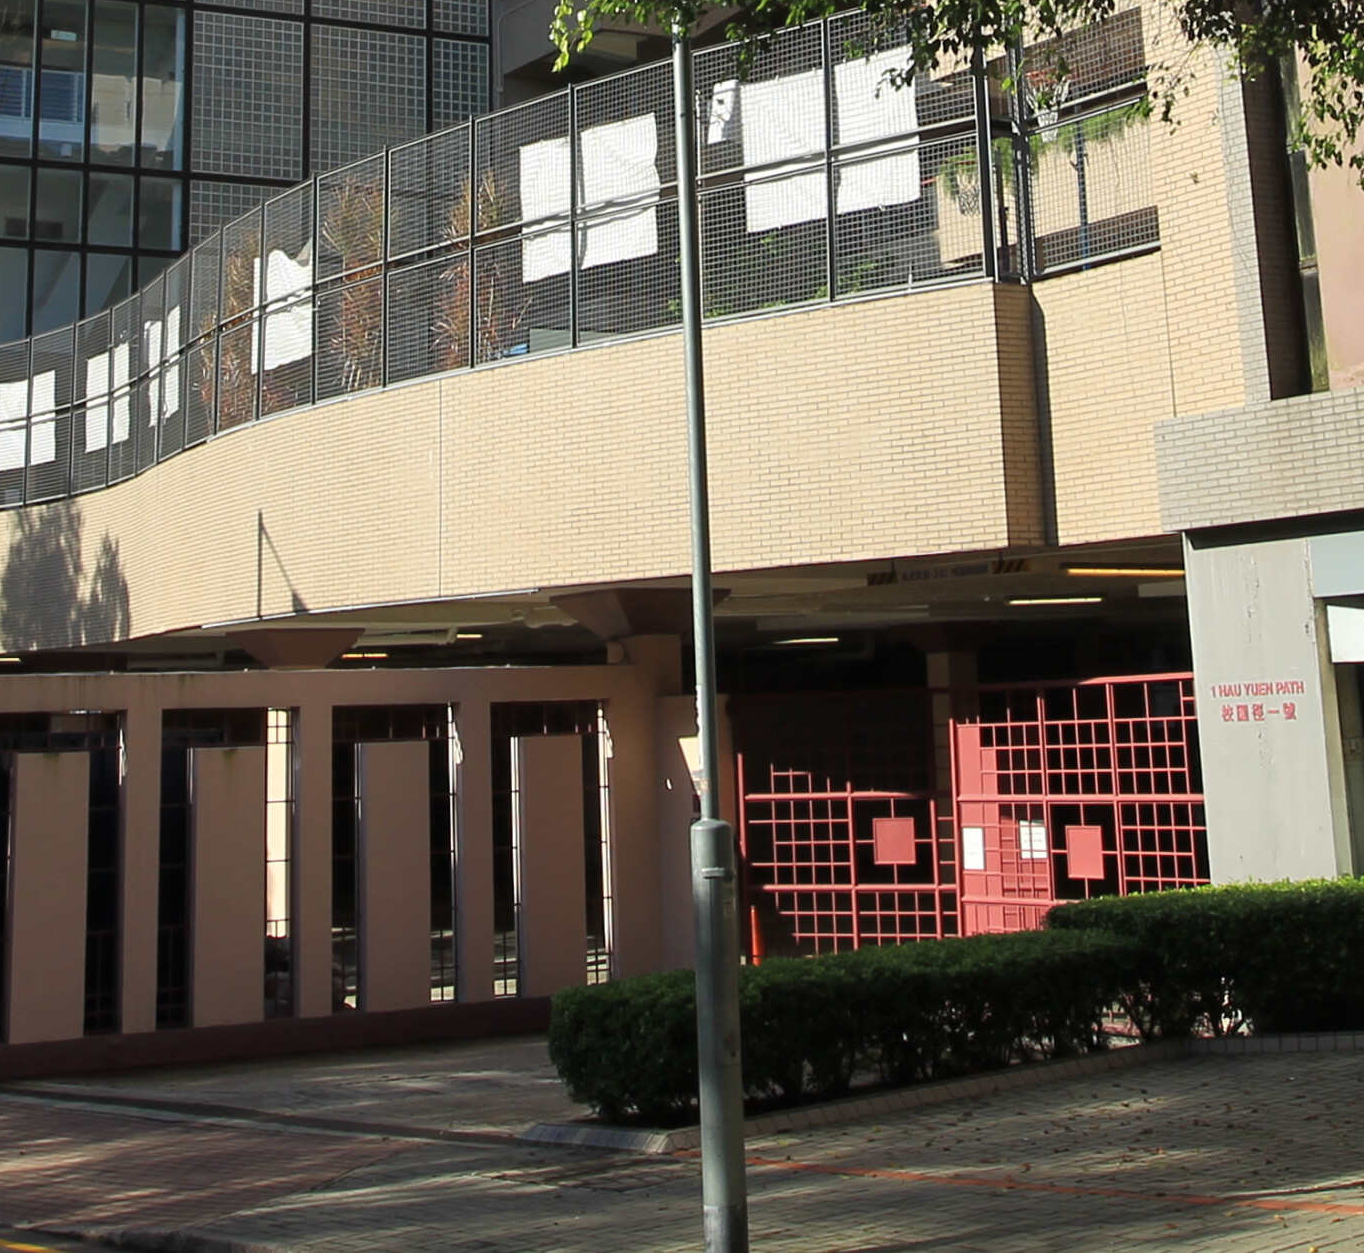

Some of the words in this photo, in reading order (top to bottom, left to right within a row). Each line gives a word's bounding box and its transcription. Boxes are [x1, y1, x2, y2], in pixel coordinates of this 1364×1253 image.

[1219, 683, 1241, 697] HAU
[1243, 682, 1273, 696] YUEN
[1275, 681, 1305, 695] PATH
